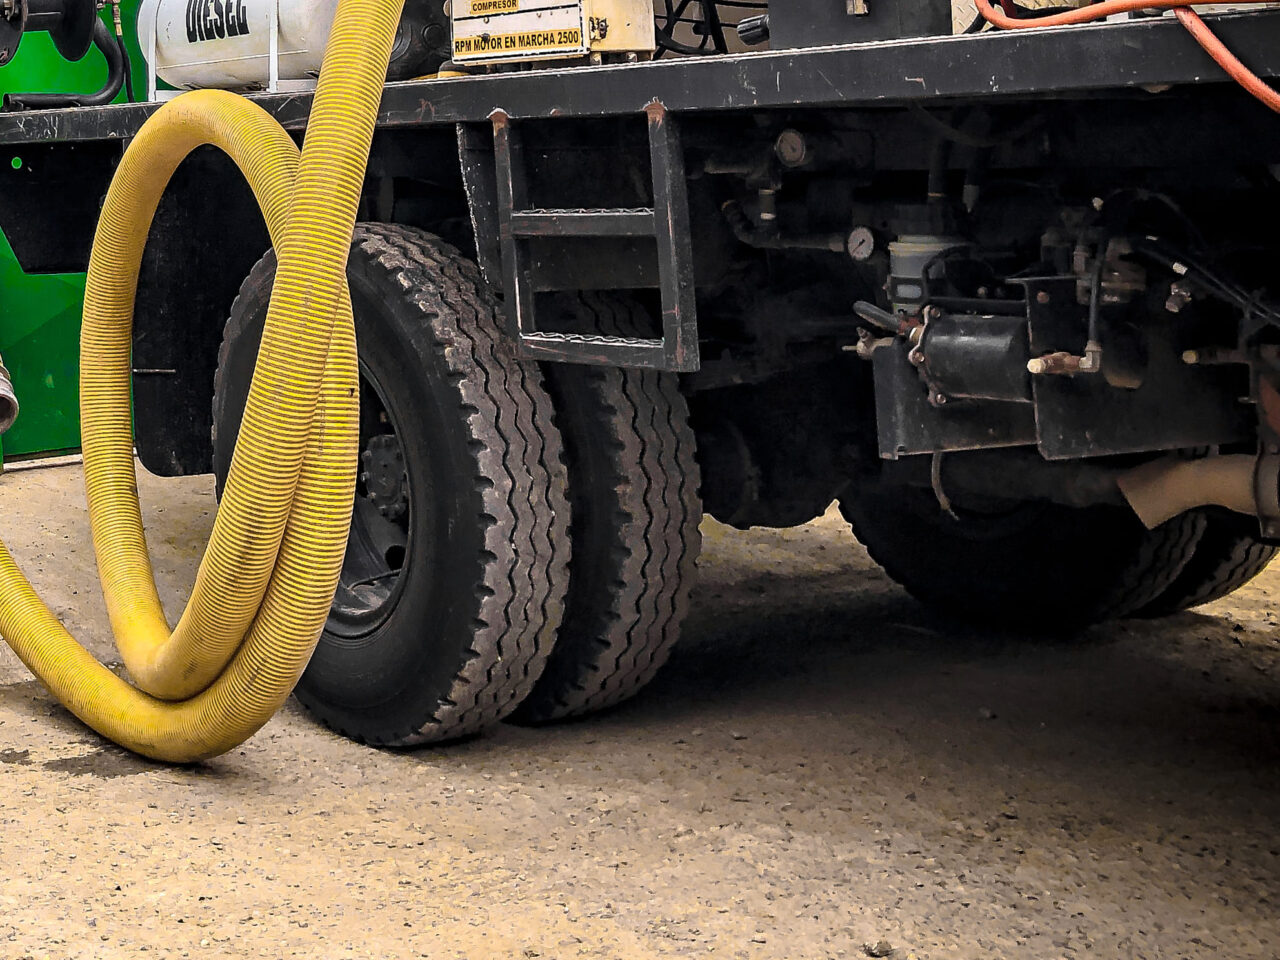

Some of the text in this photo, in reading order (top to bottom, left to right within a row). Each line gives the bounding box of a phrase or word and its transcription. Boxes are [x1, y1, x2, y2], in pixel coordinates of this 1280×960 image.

[472, 0, 517, 12] COMPRESOR
[455, 31, 579, 53] RPM MOTOR EN MARCHA 2500
